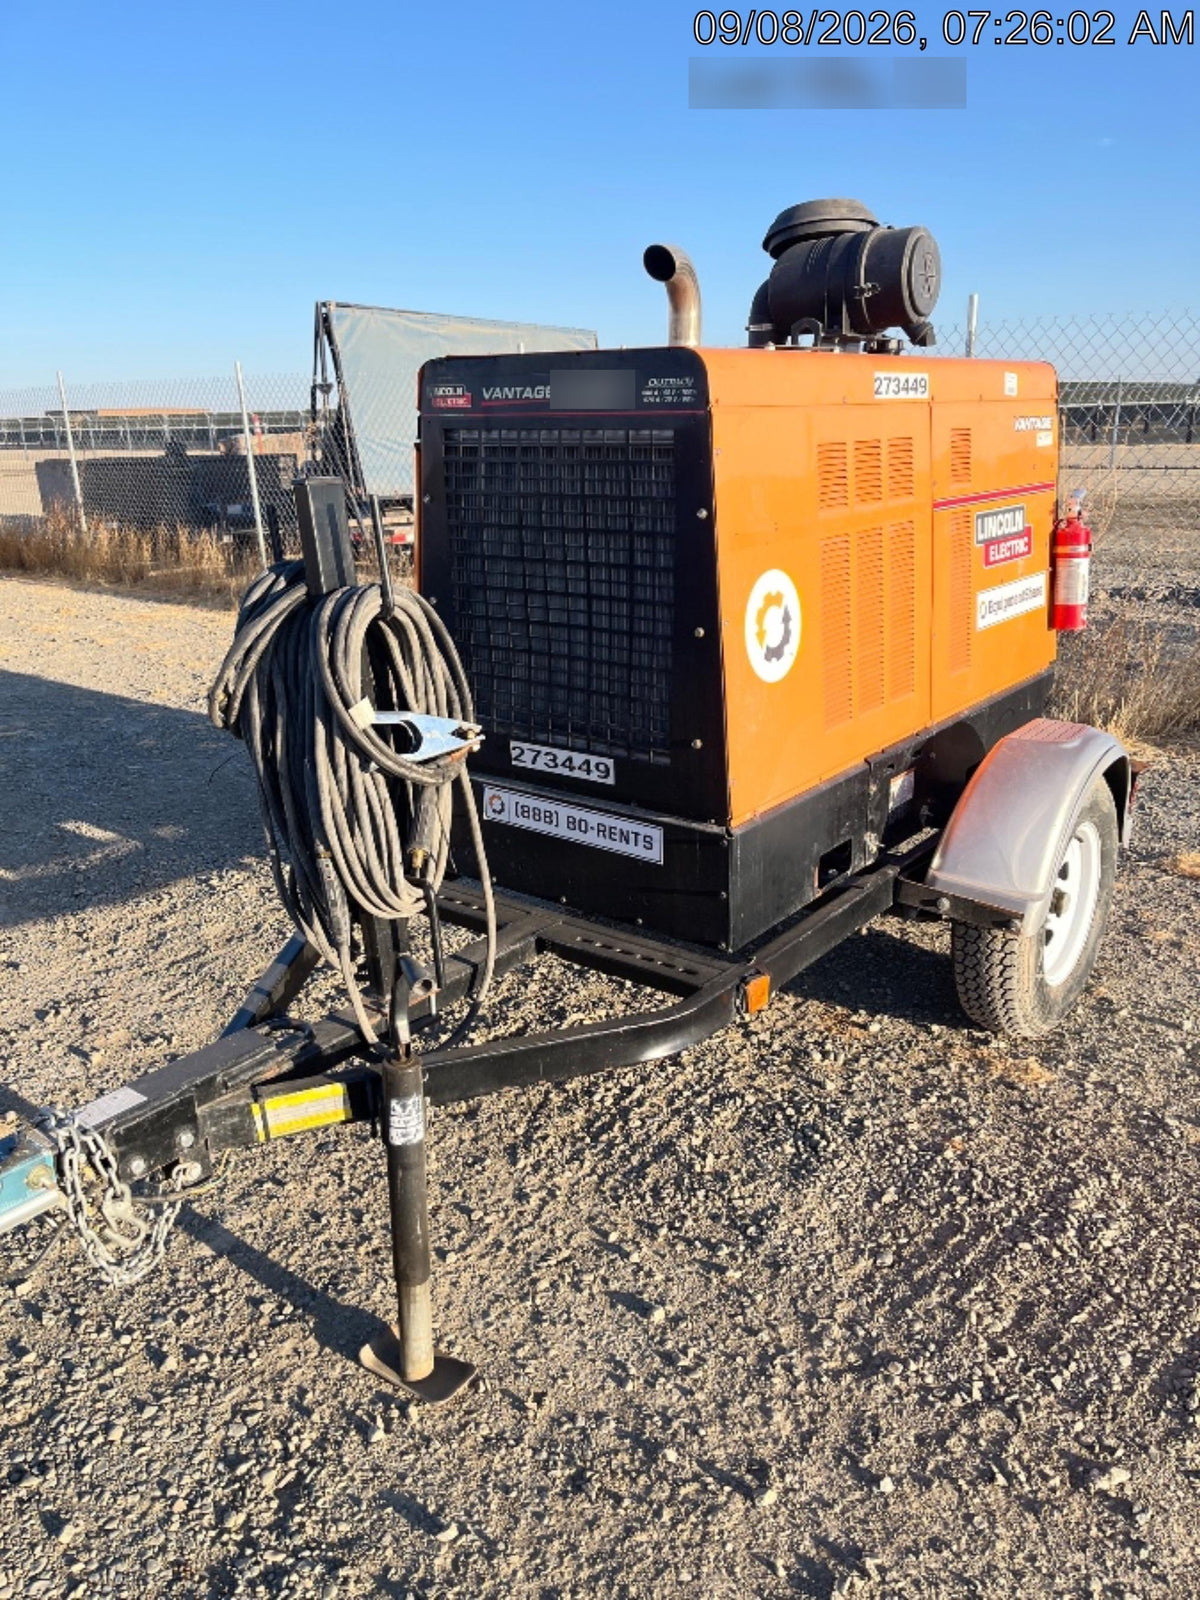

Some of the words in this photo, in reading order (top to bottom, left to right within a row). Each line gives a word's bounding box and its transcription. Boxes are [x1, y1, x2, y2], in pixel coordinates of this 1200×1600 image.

[874, 376, 927, 395] 273449
[977, 509, 1023, 542] LINCOLN
[989, 536, 1029, 562] ELECTRIC
[511, 745, 611, 780] 273449
